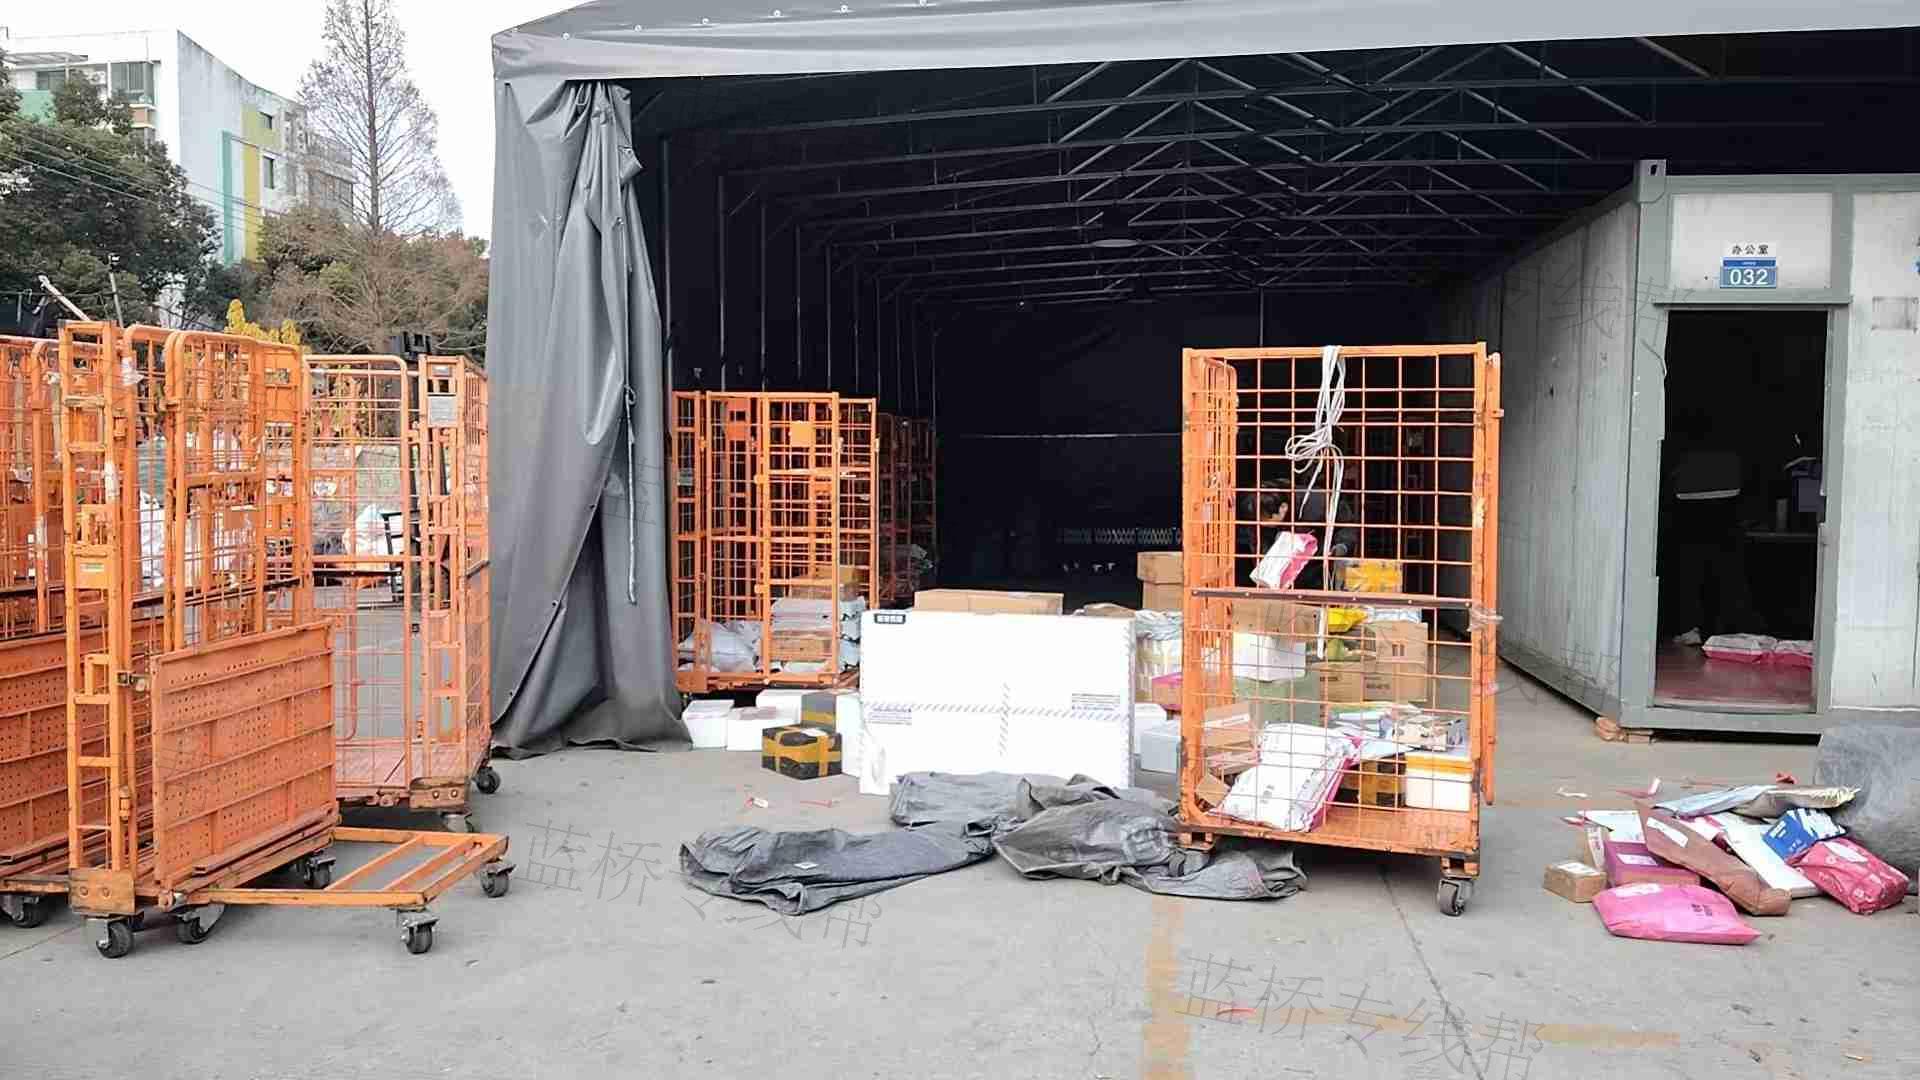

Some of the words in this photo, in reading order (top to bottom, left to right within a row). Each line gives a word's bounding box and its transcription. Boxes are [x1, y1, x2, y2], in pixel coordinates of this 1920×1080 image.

[1731, 243, 1769, 255] 办公室
[1729, 268, 1769, 285] 032
